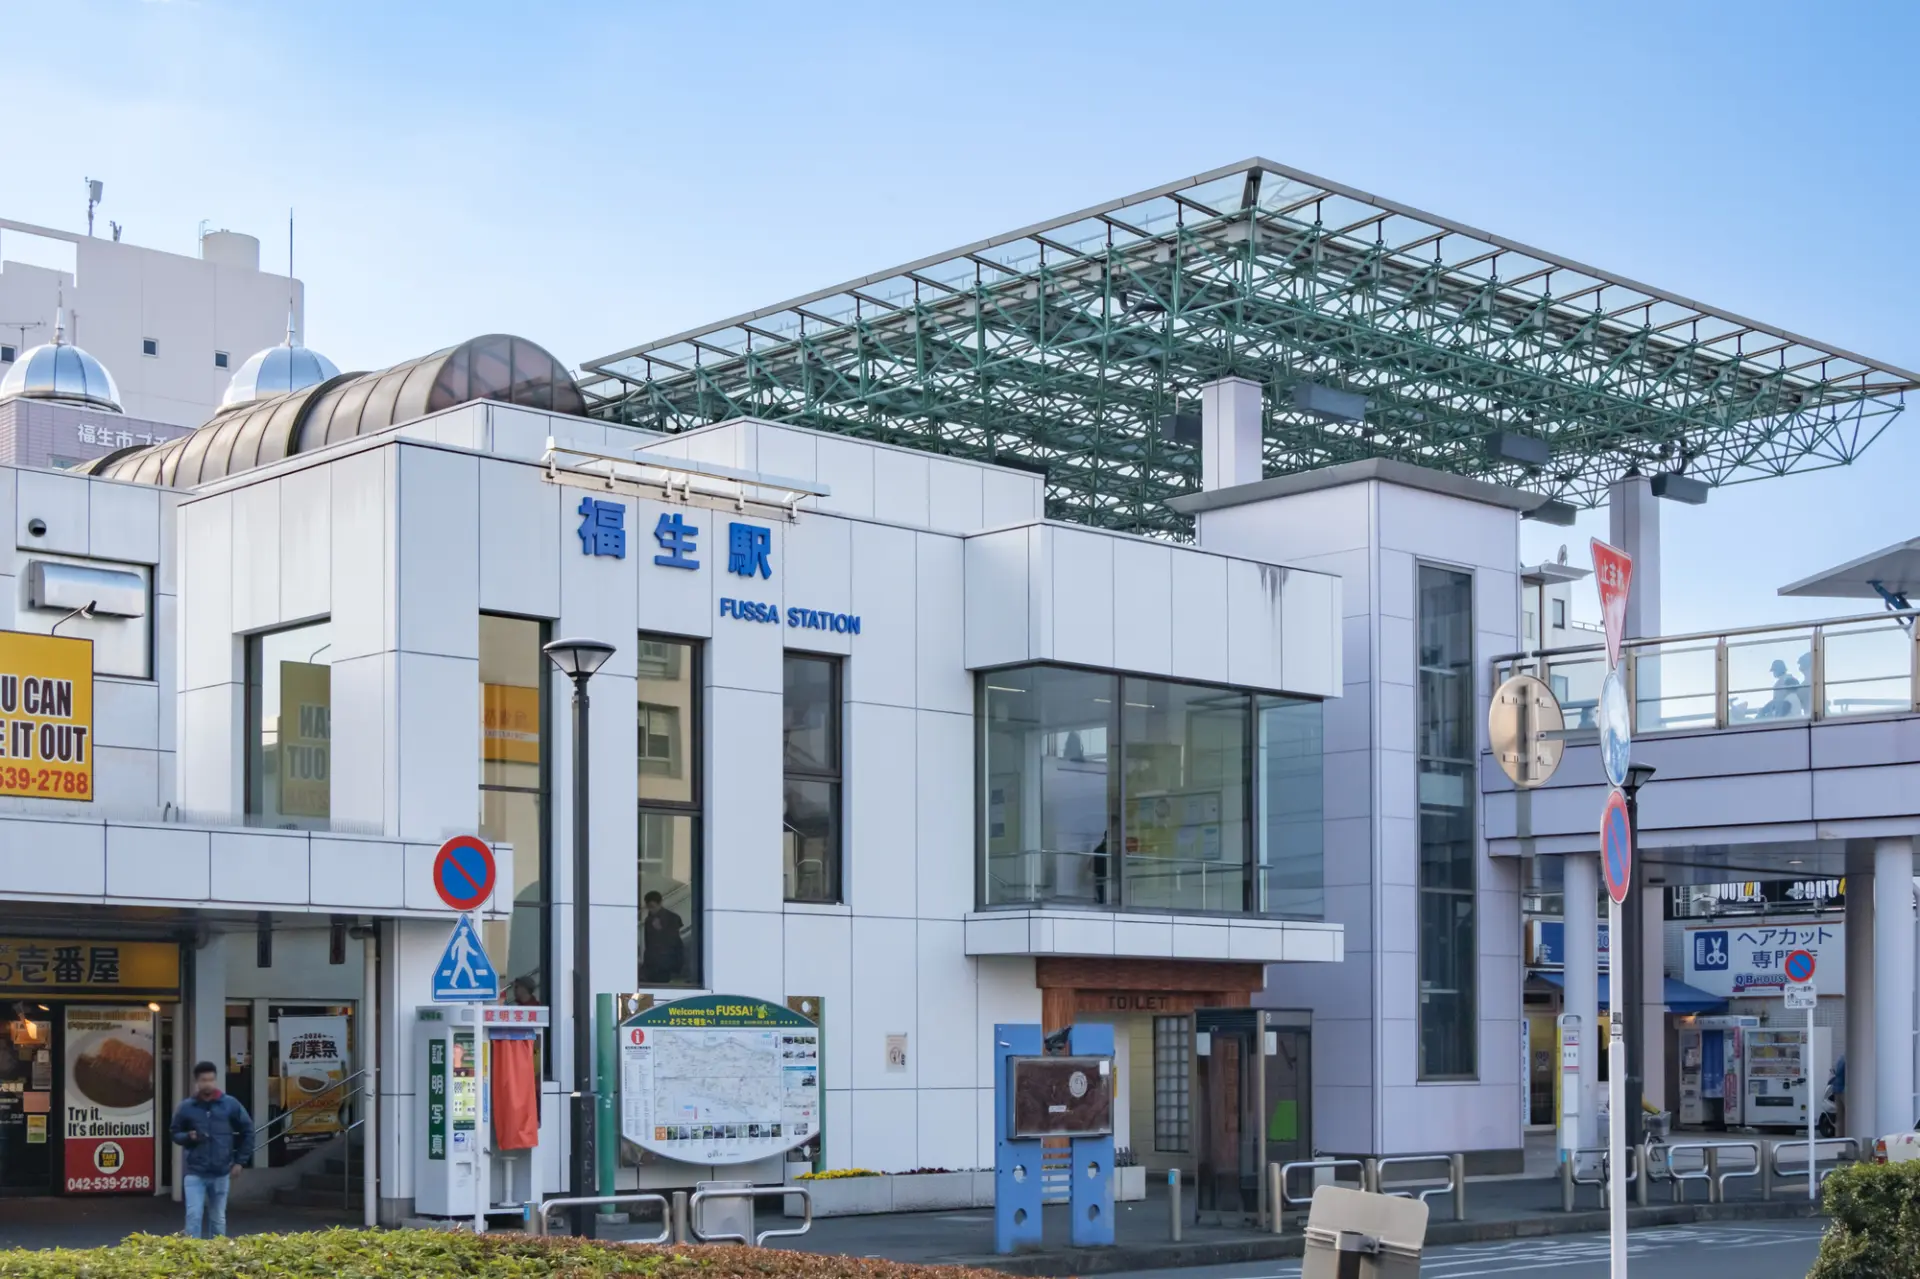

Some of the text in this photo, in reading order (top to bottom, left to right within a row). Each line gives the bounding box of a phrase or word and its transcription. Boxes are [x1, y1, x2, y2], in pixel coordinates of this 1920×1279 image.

[577, 496, 773, 580] 福生駅
[719, 597, 862, 635] FUSSA STATION
[23, 676, 73, 719] CAN
[10, 720, 36, 760] IT
[39, 722, 89, 763] OUT
[1737, 927, 1833, 947] ヘアカット
[1751, 949, 1818, 970] 専門
[1735, 974, 1755, 985] QB
[668, 1005, 753, 1017] Welcome to FUSSA!
[1107, 996, 1169, 1010] TOILET
[485, 1009, 537, 1022] 証明写真
[289, 1040, 339, 1060] 創業祭
[431, 1044, 444, 1155] 証明写真
[68, 1106, 103, 1122] Try it.
[68, 1121, 150, 1137] It's delicious!
[67, 1176, 150, 1191] 042-539-2788
